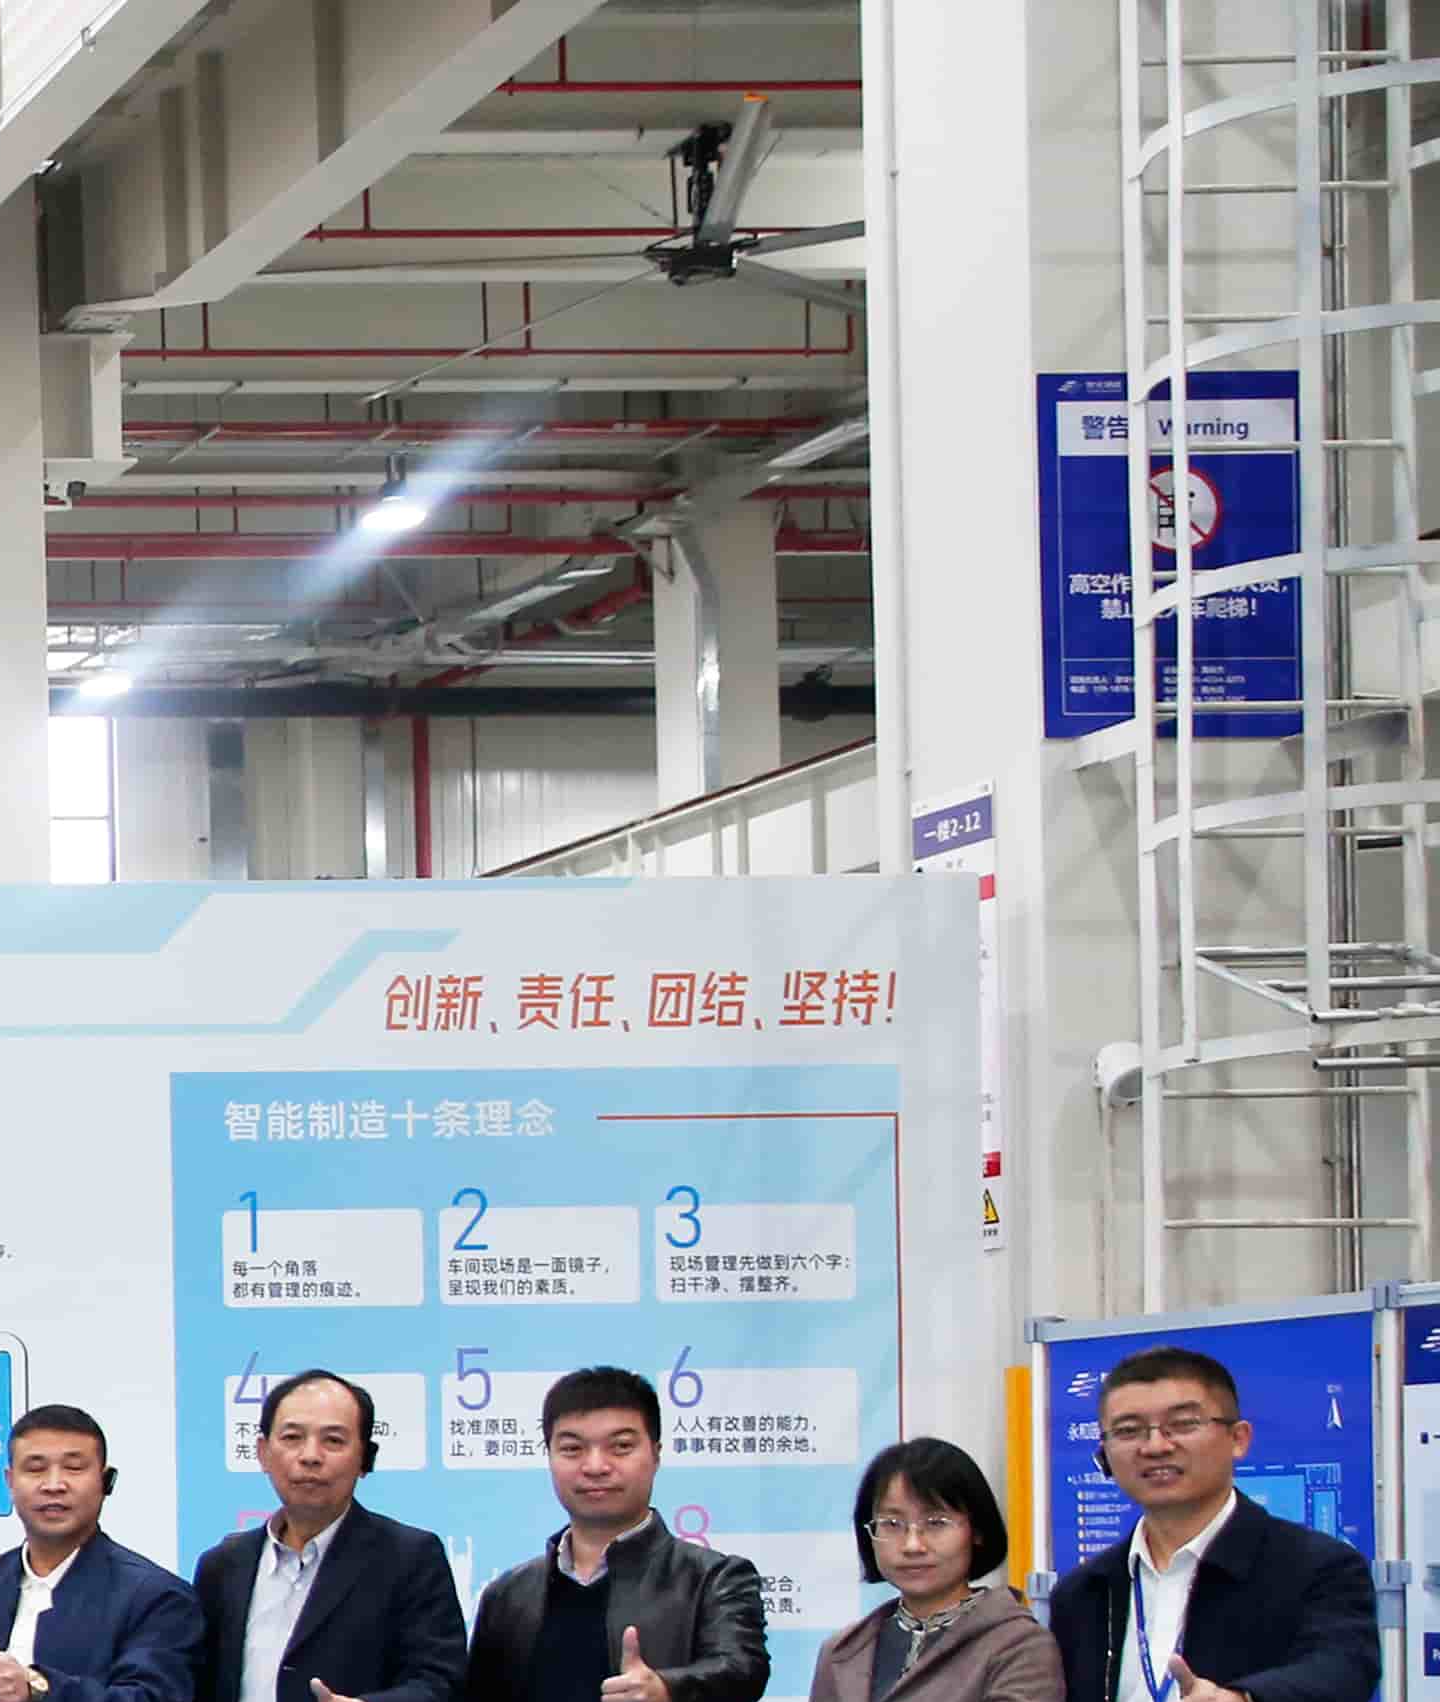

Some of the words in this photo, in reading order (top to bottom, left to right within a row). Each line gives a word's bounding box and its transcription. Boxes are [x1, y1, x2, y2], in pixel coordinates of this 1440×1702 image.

[1082, 415, 1128, 440] 警告
[1158, 417, 1249, 440] Wrning
[223, 1101, 554, 1141] 智能制造十条理念
[239, 1191, 258, 1253] 1
[451, 1187, 488, 1251] 2
[664, 1185, 701, 1249] 3
[232, 1260, 318, 1277] 每一个角落
[447, 1254, 610, 1275] 车间现场是一面镜子，
[232, 1281, 362, 1299] 都有管理的痕迹。
[447, 1278, 576, 1297] 呈现我们的素质。
[670, 1275, 799, 1294] 扫干净、摆整齐。
[456, 1347, 491, 1410] 5
[668, 1345, 704, 1408] 6
[672, 1415, 818, 1433] 人人有改善的能力，
[672, 1437, 818, 1454] 事事有改善的余地。
